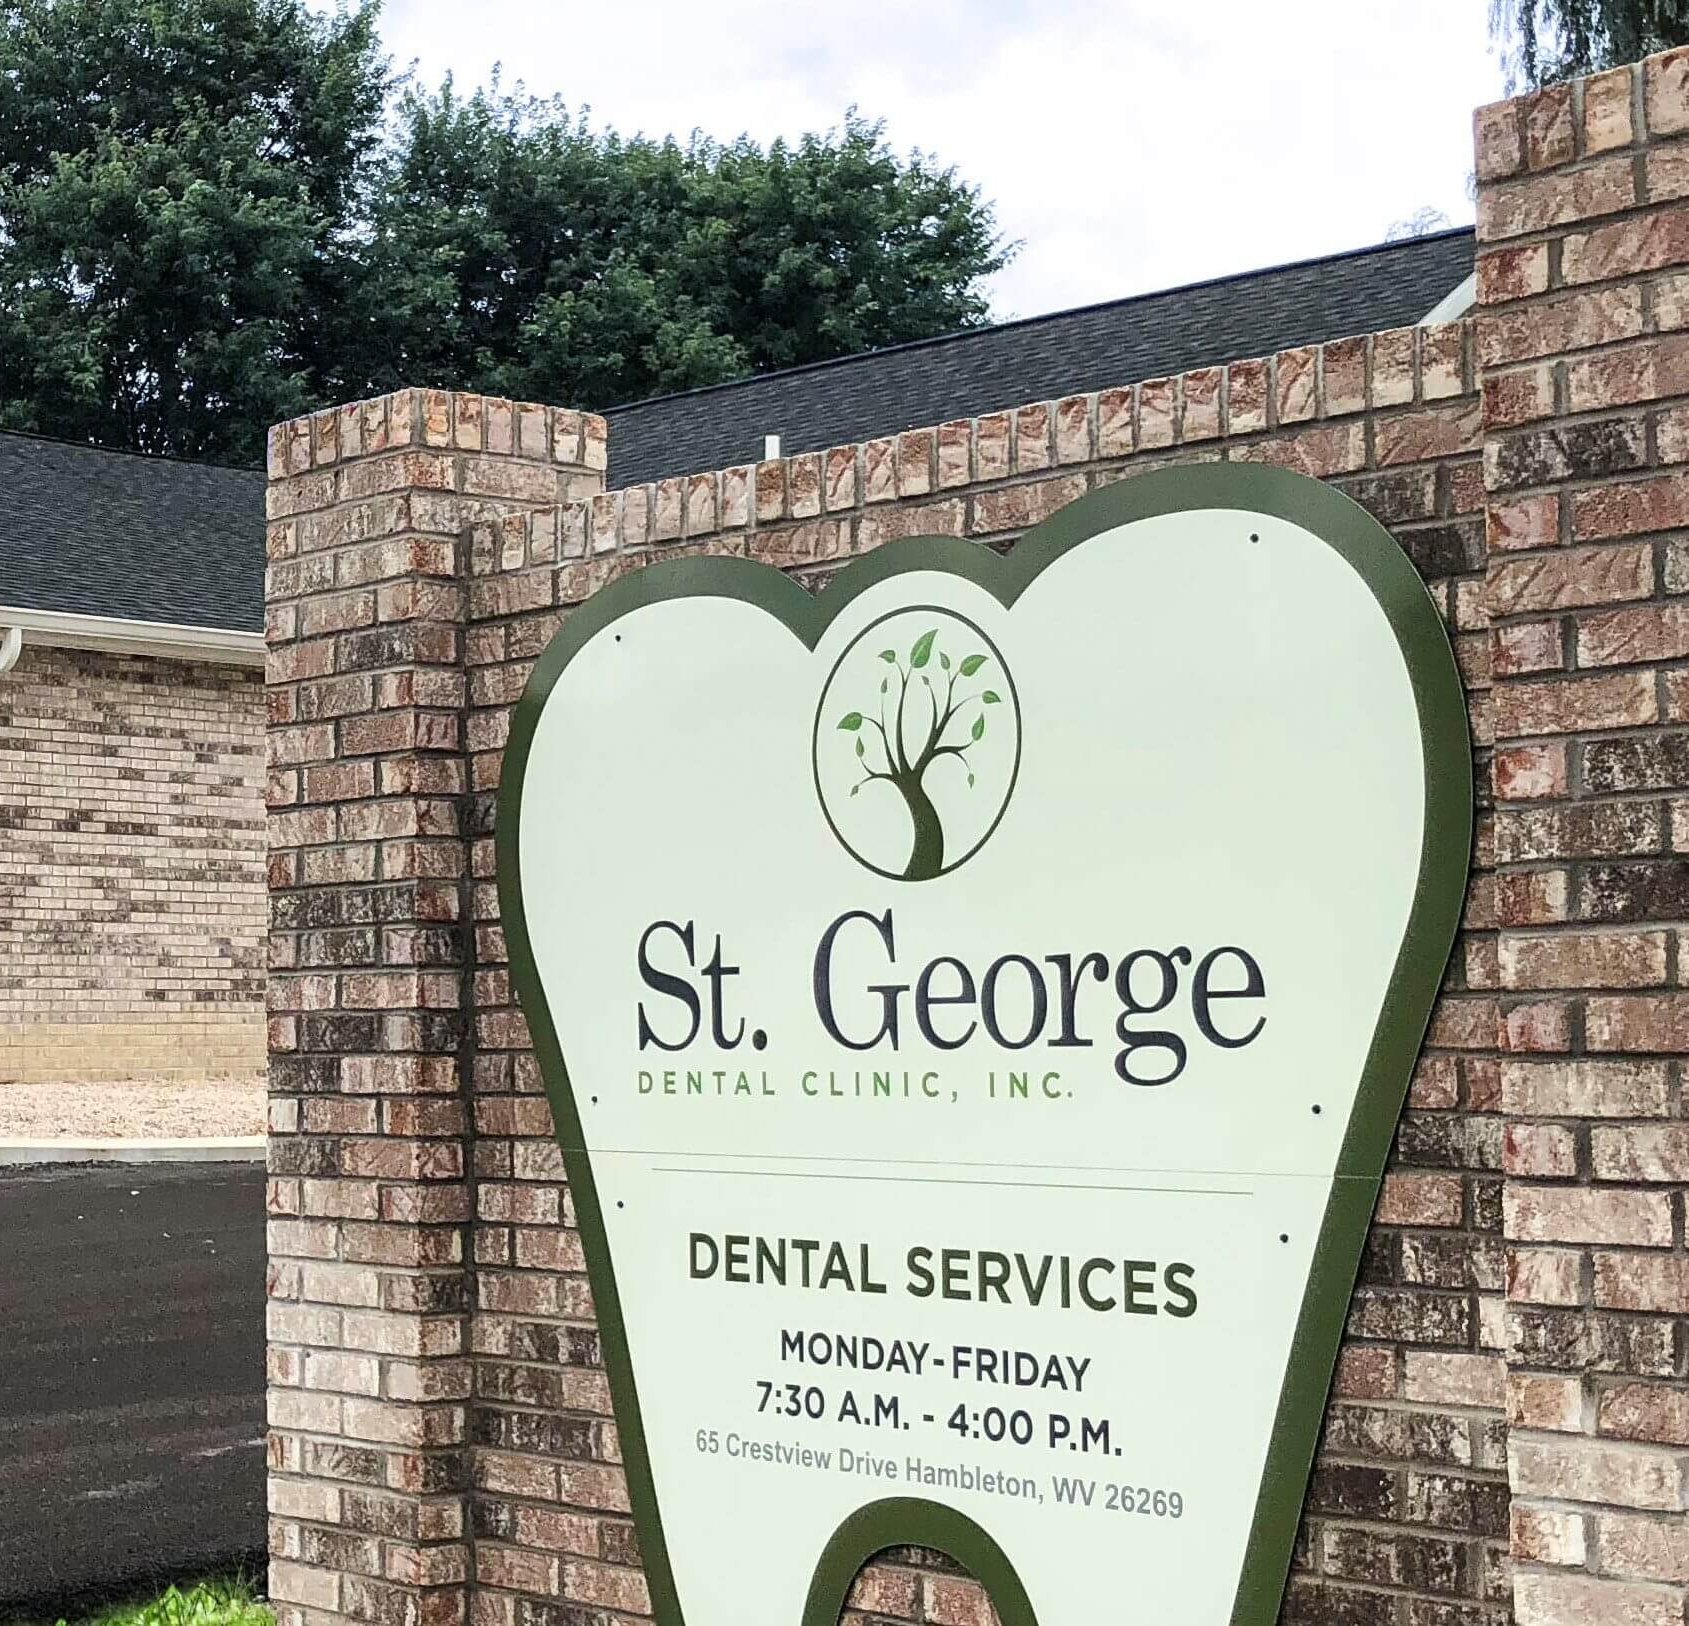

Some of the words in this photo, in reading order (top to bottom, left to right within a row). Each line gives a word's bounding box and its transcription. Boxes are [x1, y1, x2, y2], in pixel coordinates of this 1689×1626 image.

[637, 919, 768, 1052] St.
[812, 908, 1267, 1087] George
[638, 1070, 776, 1096] DENTAL
[801, 1070, 959, 1103] CLINIC,
[989, 1071, 1074, 1099] INC.
[689, 1232, 887, 1294] DENTAL
[905, 1246, 1198, 1319] SERVICES
[756, 1380, 825, 1420] 7:30
[837, 1390, 910, 1431] A.M.
[947, 1403, 1034, 1446] 4:00
[1048, 1413, 1123, 1457] P.M.
[696, 1429, 720, 1454] 65
[726, 1433, 832, 1470] Crestview
[839, 1447, 898, 1479] Drive
[906, 1457, 1045, 1504] Hambleton,
[1052, 1476, 1096, 1506] WV
[1105, 1484, 1184, 1520] 26269
